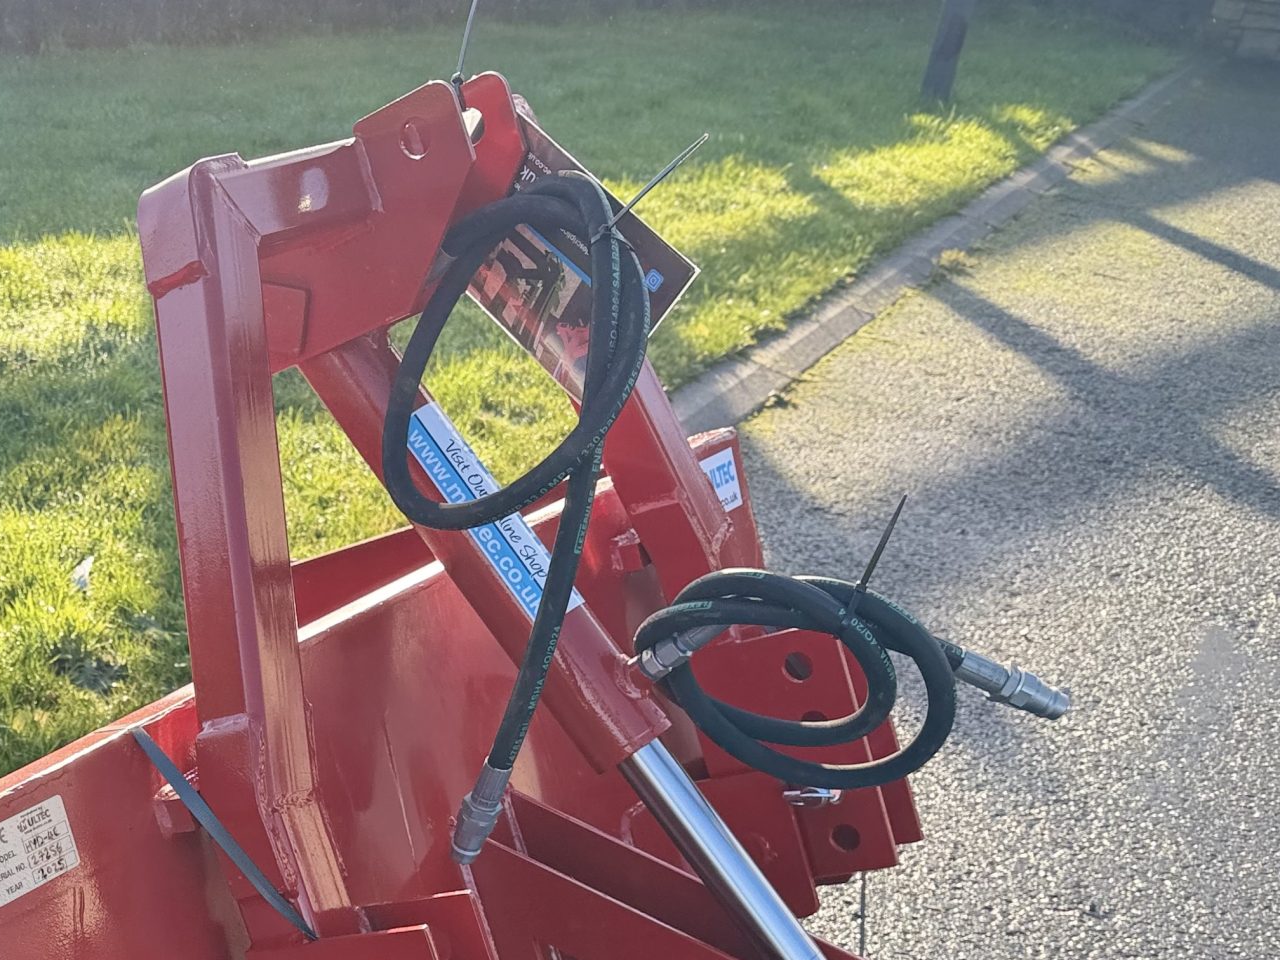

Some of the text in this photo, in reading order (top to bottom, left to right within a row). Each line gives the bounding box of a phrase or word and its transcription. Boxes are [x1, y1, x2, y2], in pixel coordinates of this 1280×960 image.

[446, 438, 471, 474] Visit
[498, 514, 522, 544] line
[519, 543, 548, 578] Shop
[837, 606, 878, 647] 4Q/204
[6, 881, 23, 896] YEAR
